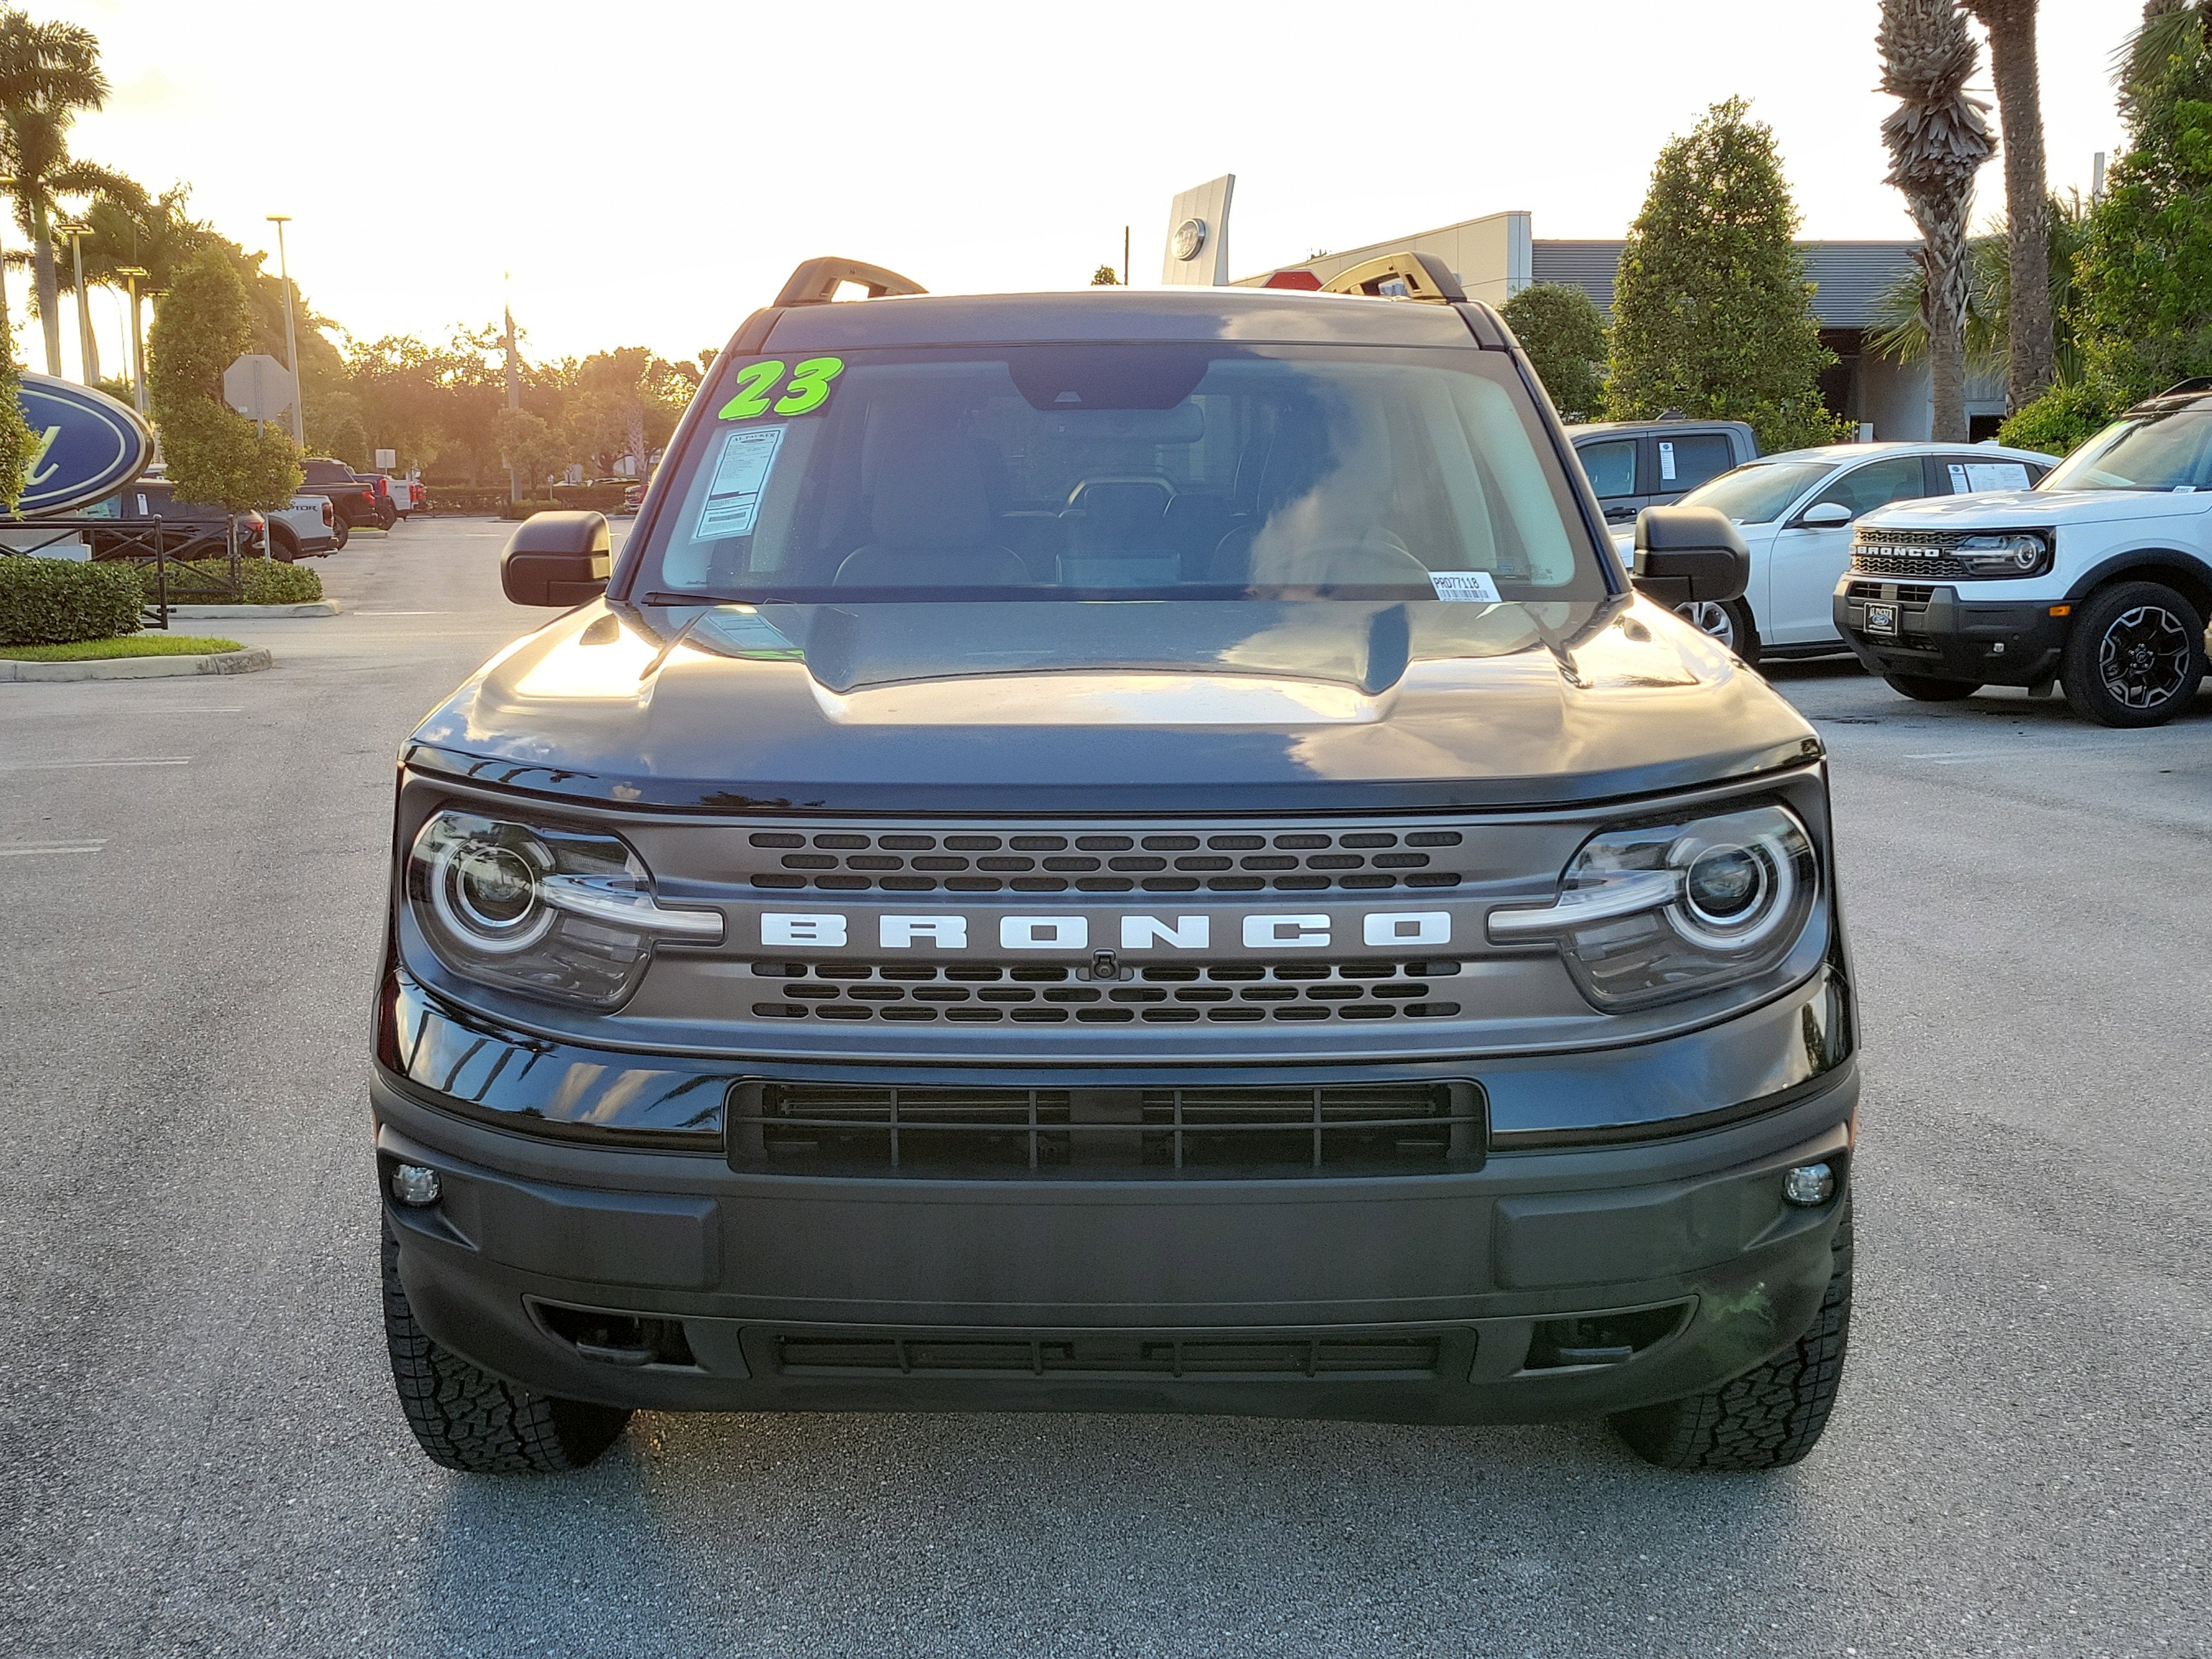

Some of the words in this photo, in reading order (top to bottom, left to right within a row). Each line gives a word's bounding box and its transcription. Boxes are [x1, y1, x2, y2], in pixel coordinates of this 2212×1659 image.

[718, 357, 845, 421] 23
[1857, 546, 1940, 557] BRONCO
[760, 911, 1452, 949] BRONCO
